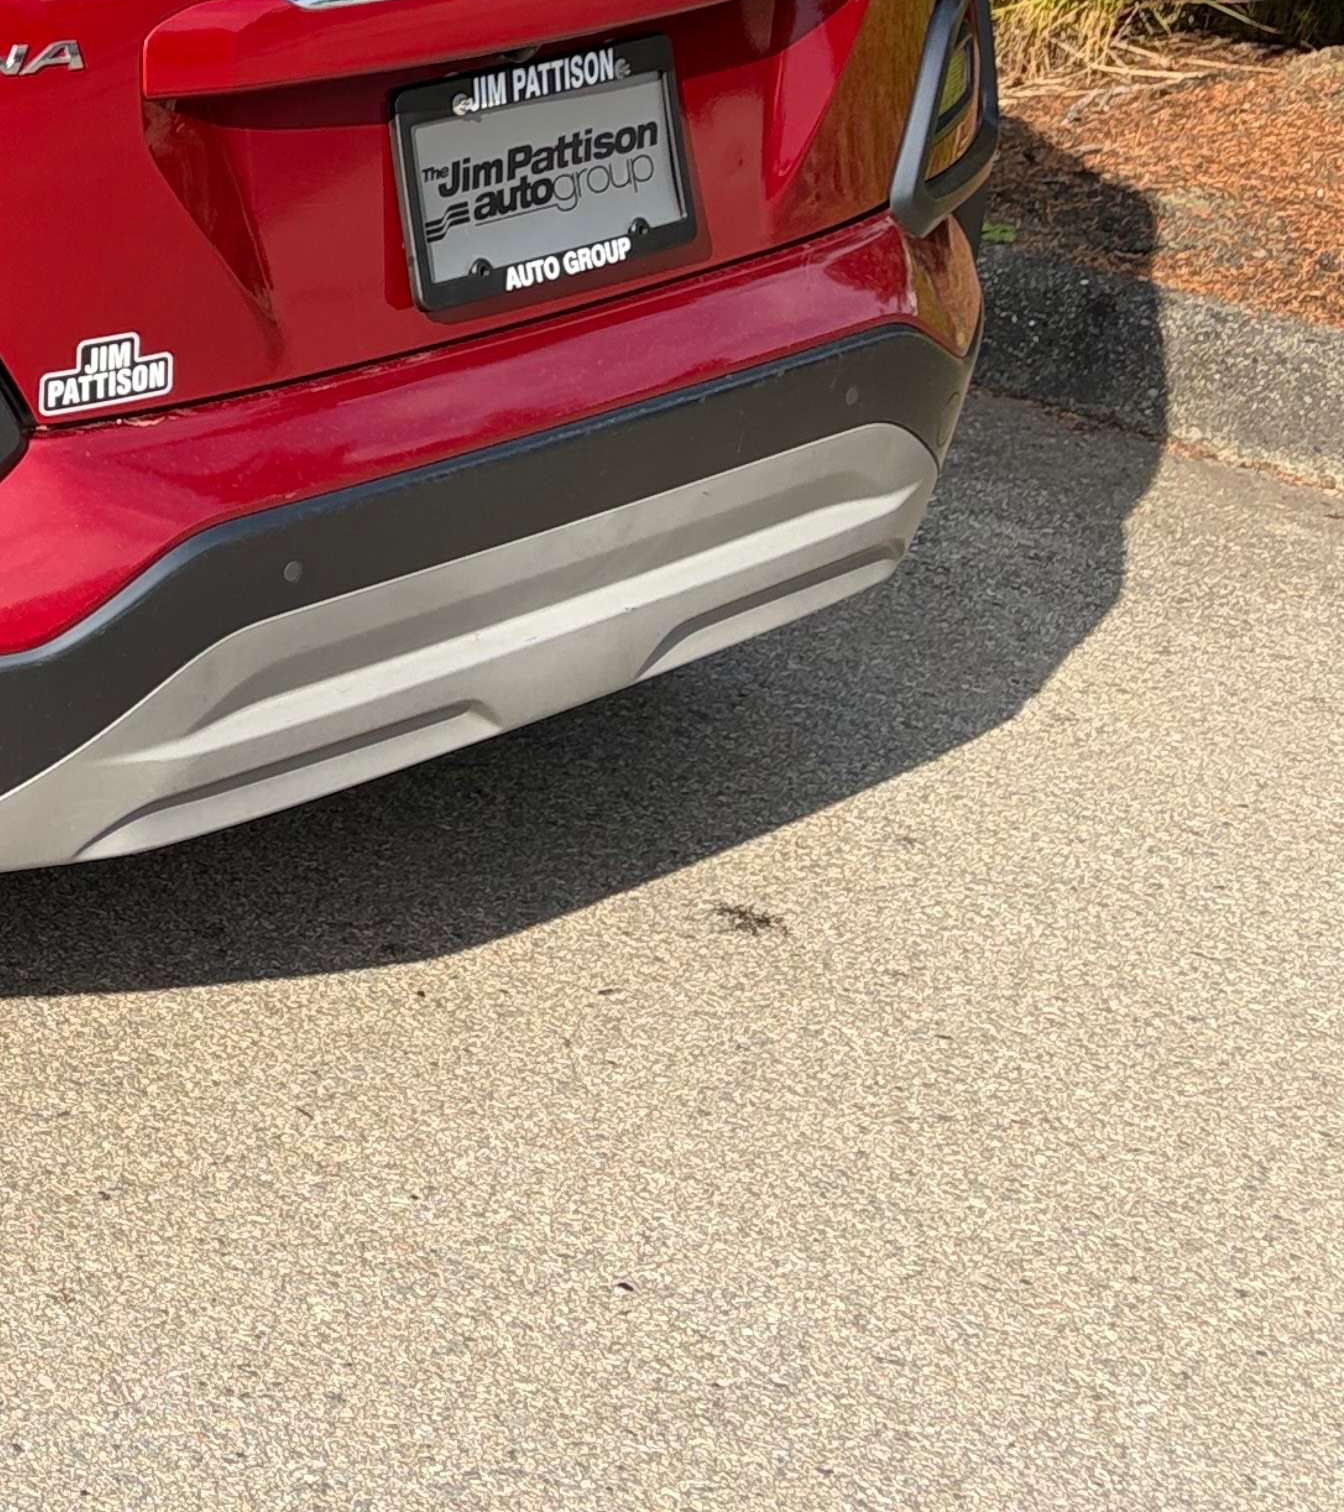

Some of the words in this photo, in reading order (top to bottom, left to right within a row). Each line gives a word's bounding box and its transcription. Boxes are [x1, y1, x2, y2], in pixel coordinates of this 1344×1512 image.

[469, 72, 507, 112] JIM
[513, 47, 614, 102] PATTISON
[422, 165, 449, 183] The
[505, 255, 560, 291] AUTO
[563, 237, 631, 274] GROUP
[84, 341, 132, 374] JIM
[47, 360, 165, 408] PATTISON
